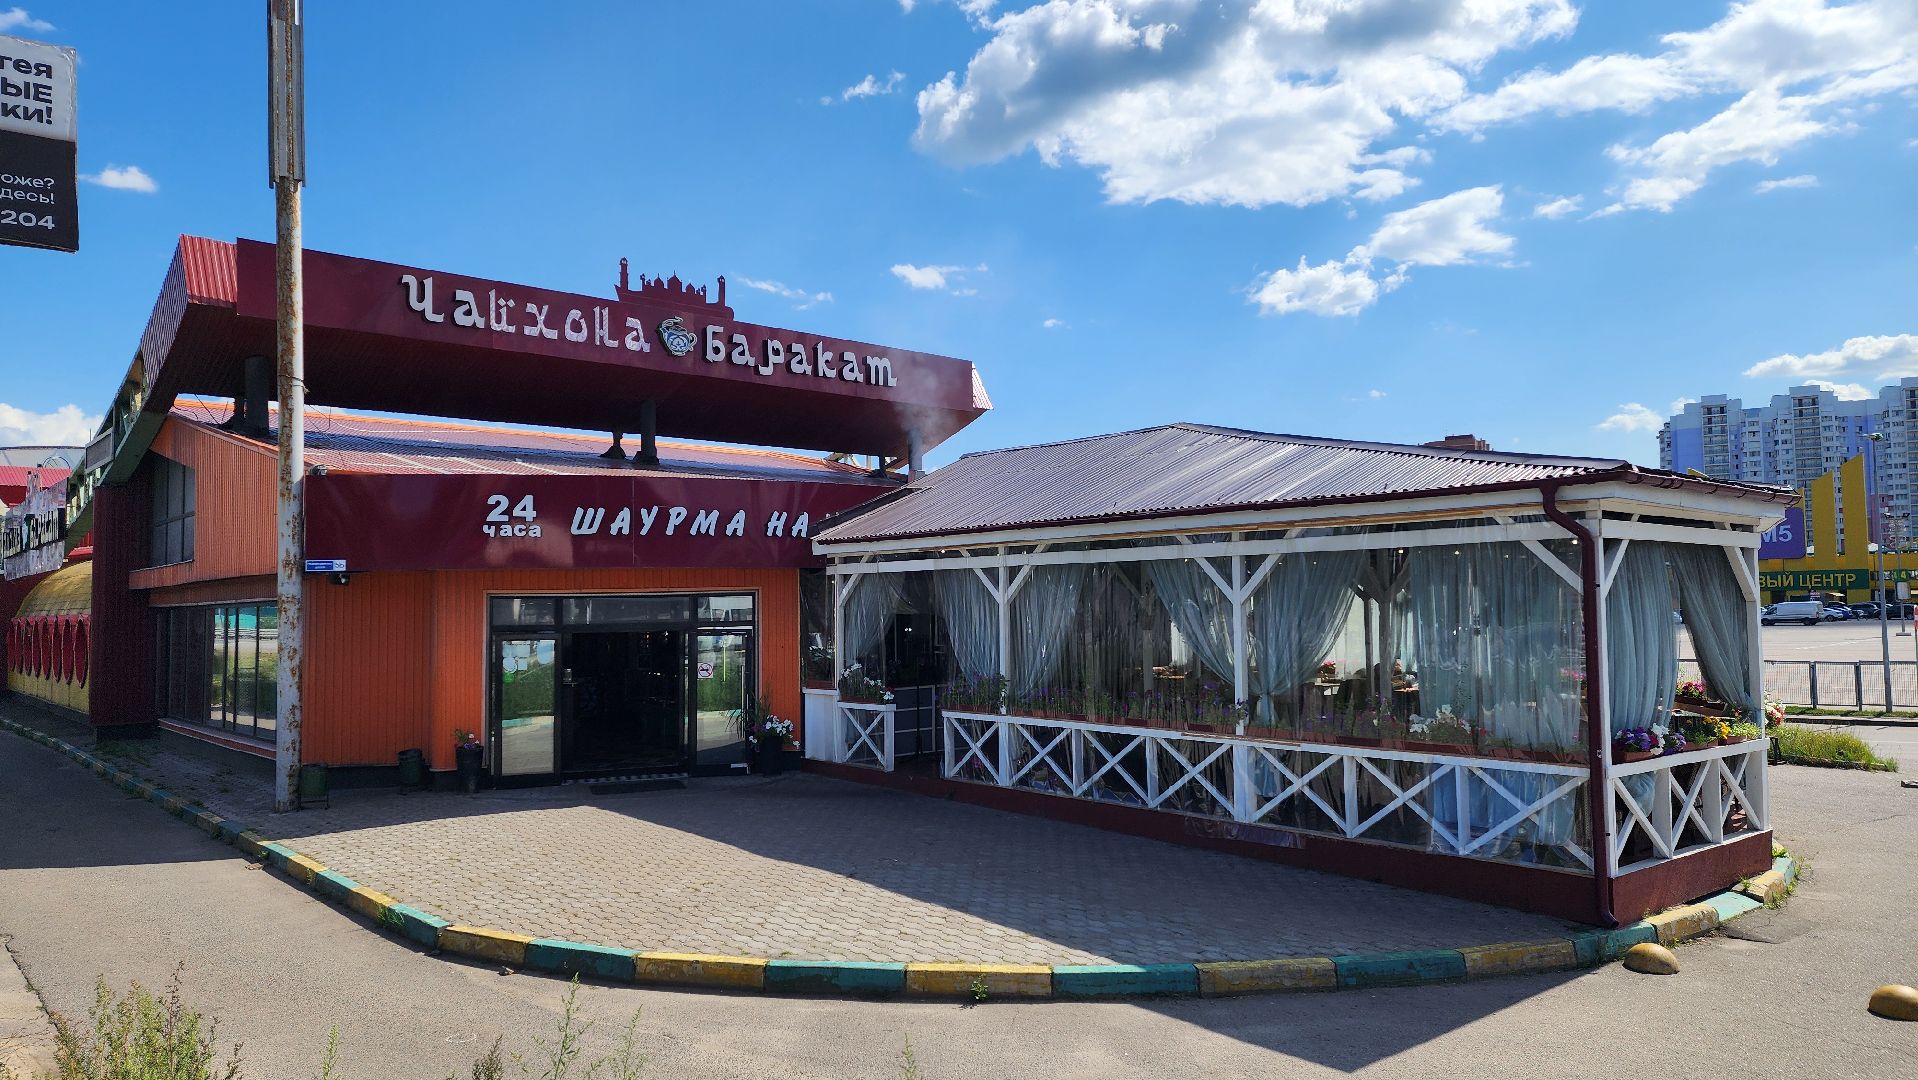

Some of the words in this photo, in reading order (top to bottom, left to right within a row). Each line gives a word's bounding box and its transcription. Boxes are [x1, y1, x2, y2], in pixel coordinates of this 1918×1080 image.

[1, 102, 53, 125] ки!
[0, 174, 55, 190] оже?
[1, 209, 56, 230] 204
[401, 274, 650, 353] Чайхона
[486, 494, 537, 522] 24
[483, 523, 542, 538] часа
[570, 505, 746, 537] ШАУРМА
[767, 511, 809, 537] НА
[1799, 573, 1857, 589] ЦЕНТР
